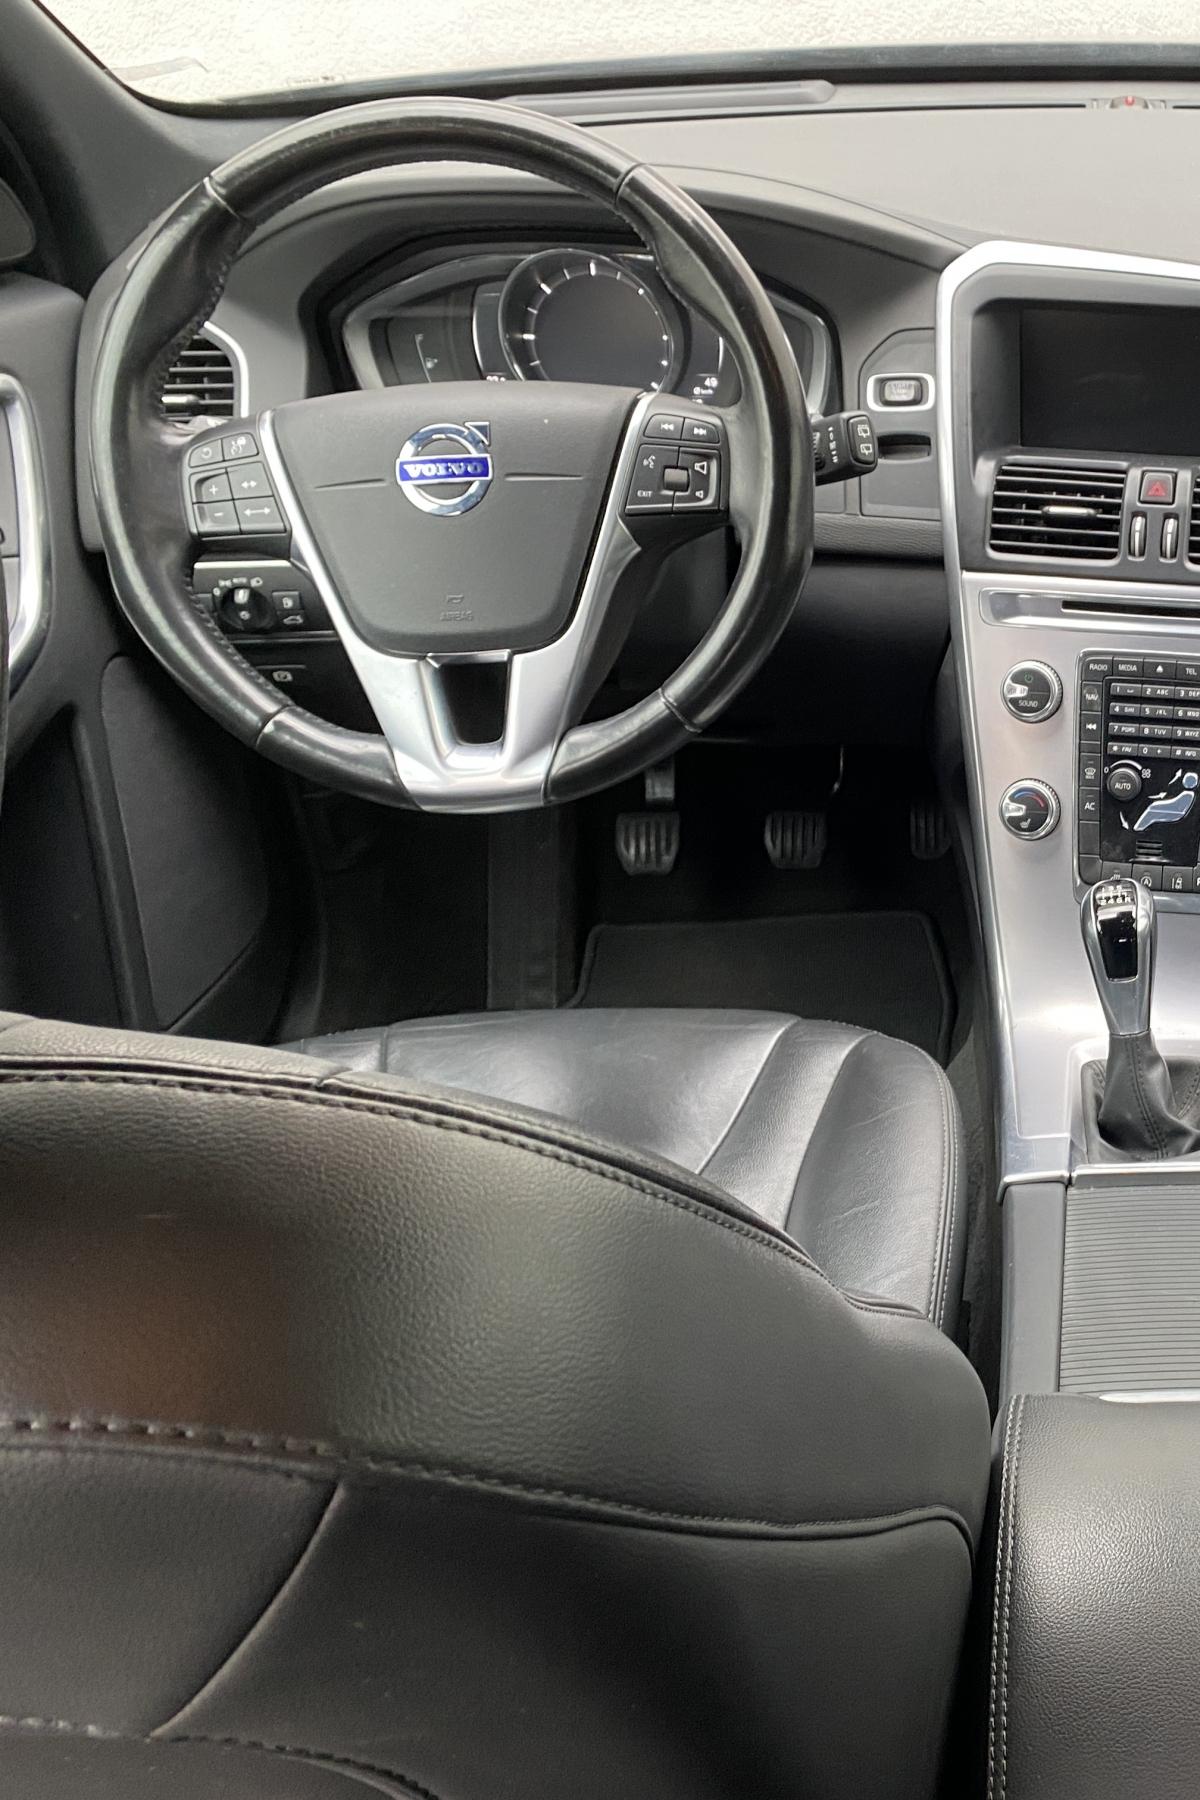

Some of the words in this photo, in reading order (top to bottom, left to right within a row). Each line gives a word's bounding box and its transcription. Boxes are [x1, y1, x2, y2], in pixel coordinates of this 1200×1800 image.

[403, 462, 483, 478] VOLVO
[637, 490, 652, 498] EXIT
[1118, 664, 1138, 672] MEDIA
[1185, 668, 1197, 676] TEL
[1085, 693, 1099, 701] NAV
[1018, 699, 1038, 708] SOUND
[1114, 782, 1132, 790] AUTO
[1085, 802, 1095, 810] AC
